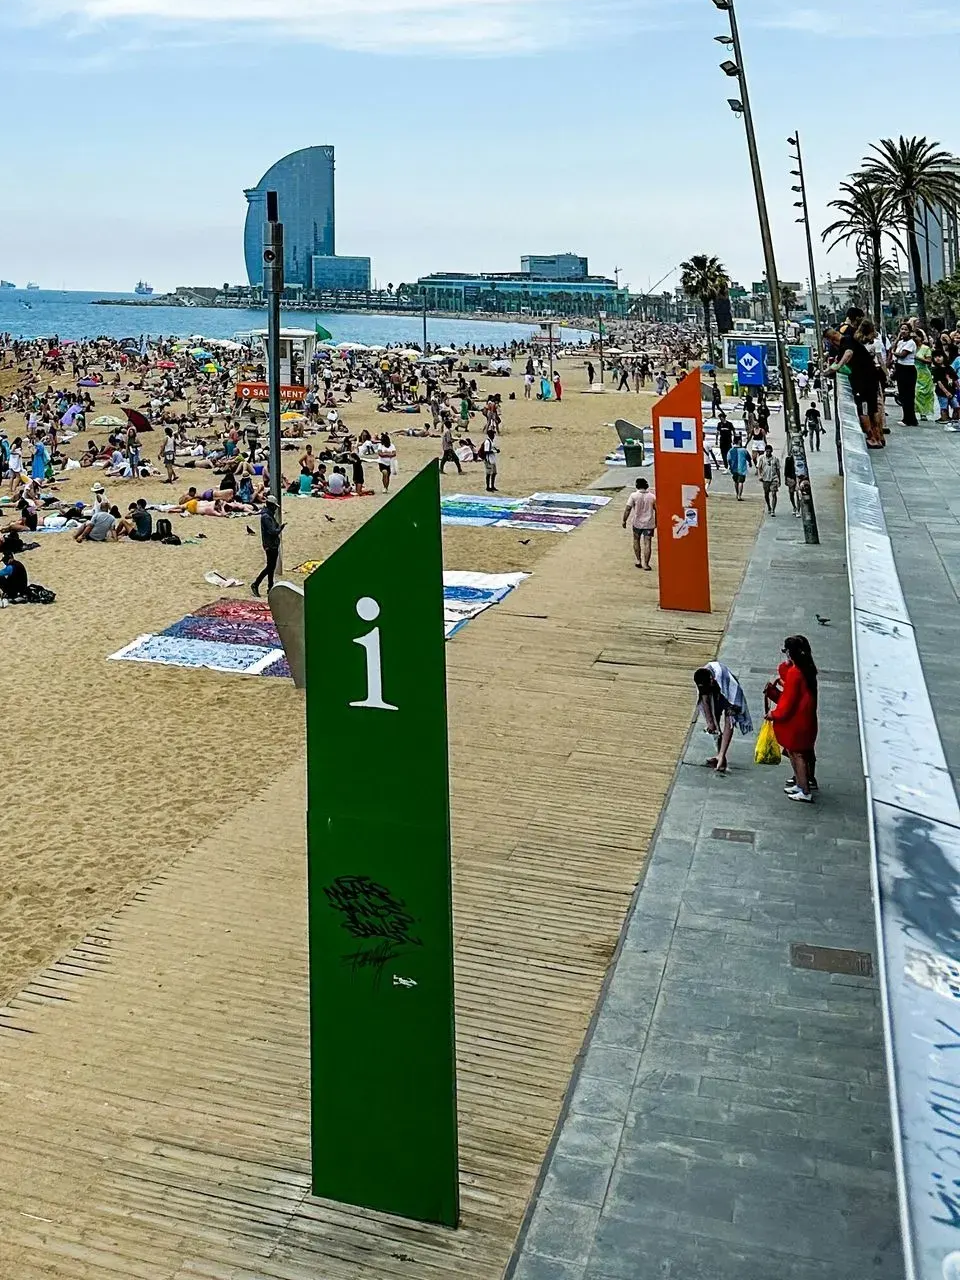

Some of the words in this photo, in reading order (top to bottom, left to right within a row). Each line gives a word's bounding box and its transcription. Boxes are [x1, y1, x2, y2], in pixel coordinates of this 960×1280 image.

[743, 358, 754, 367] W
[253, 388, 304, 398] SALMENT
[349, 596, 399, 710] i
